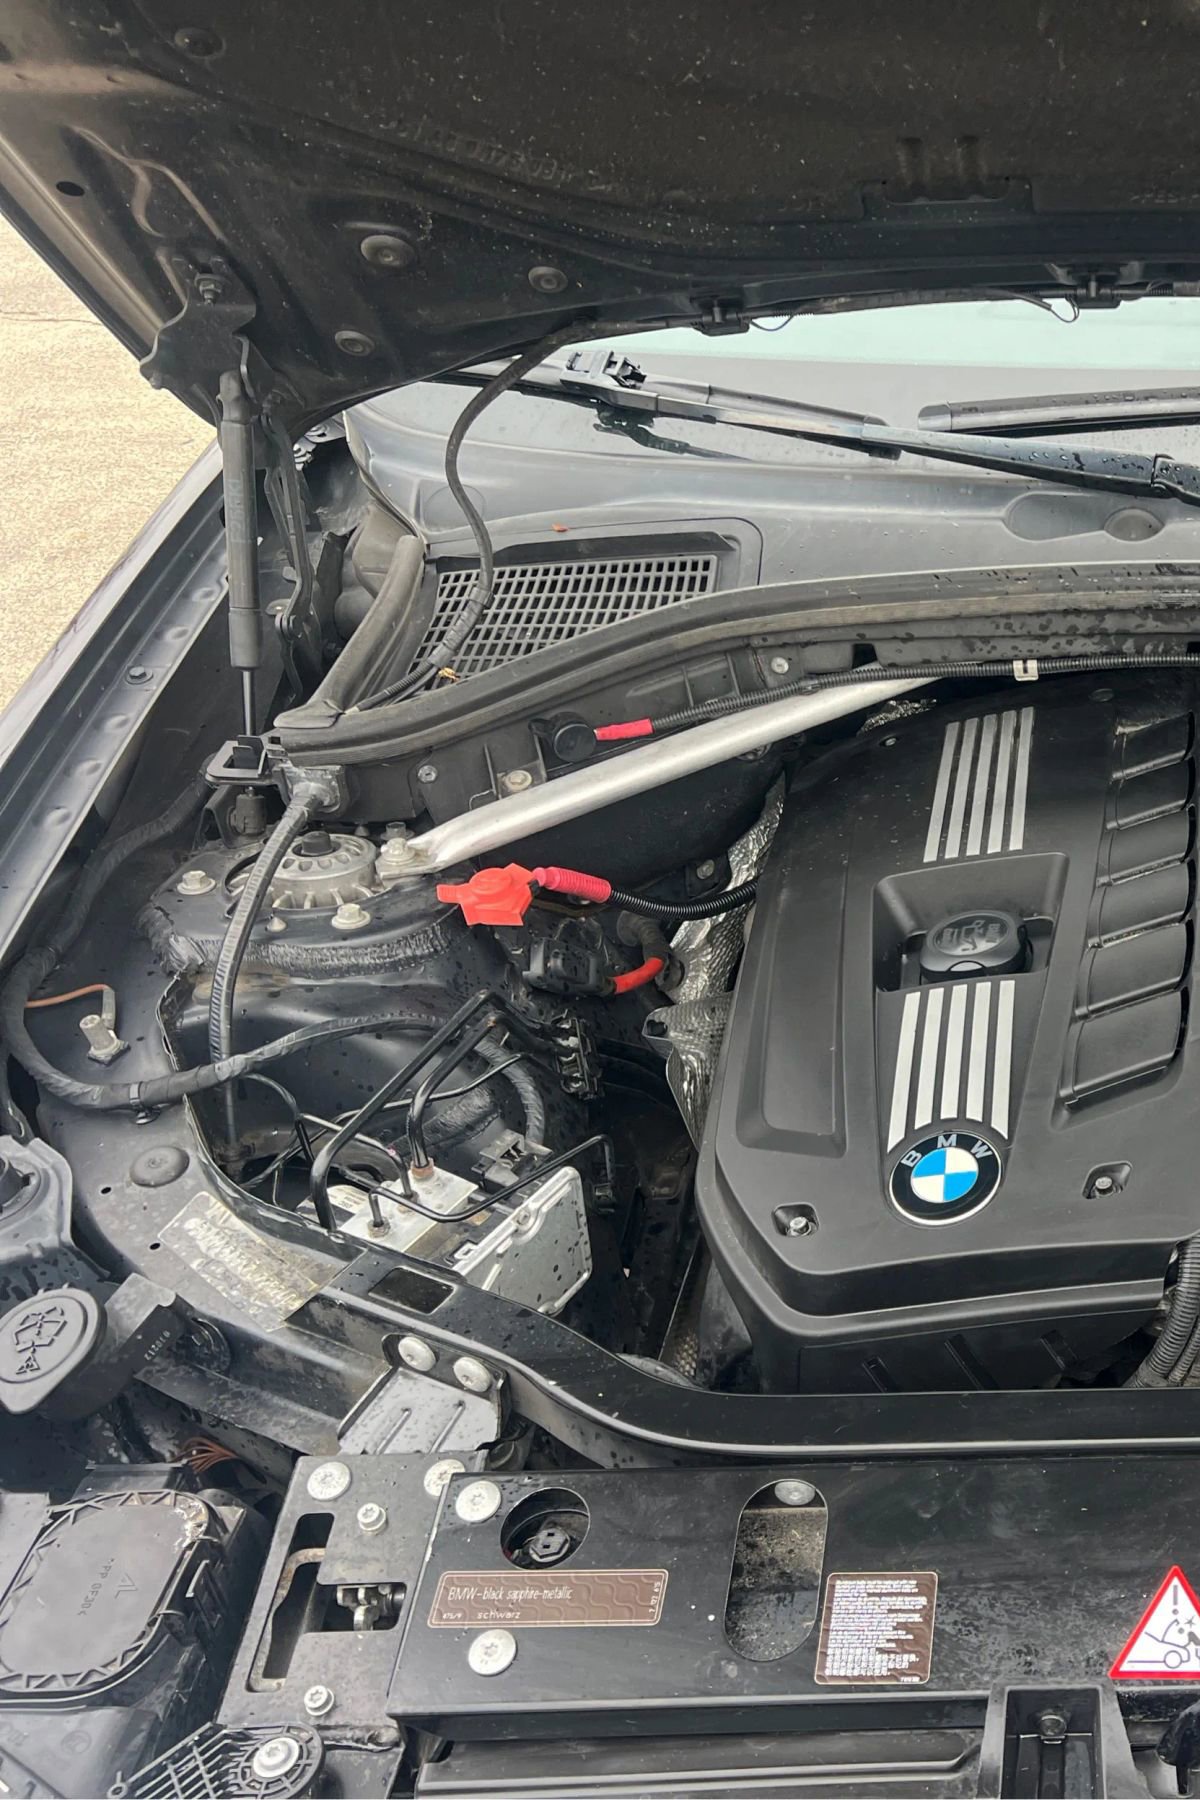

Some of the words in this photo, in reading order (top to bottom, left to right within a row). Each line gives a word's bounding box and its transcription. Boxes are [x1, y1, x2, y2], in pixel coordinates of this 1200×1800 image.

[900, 1133, 993, 1168] BMW
[448, 1586, 505, 1600] BMW-black
[477, 1610, 521, 1619] schwarz
